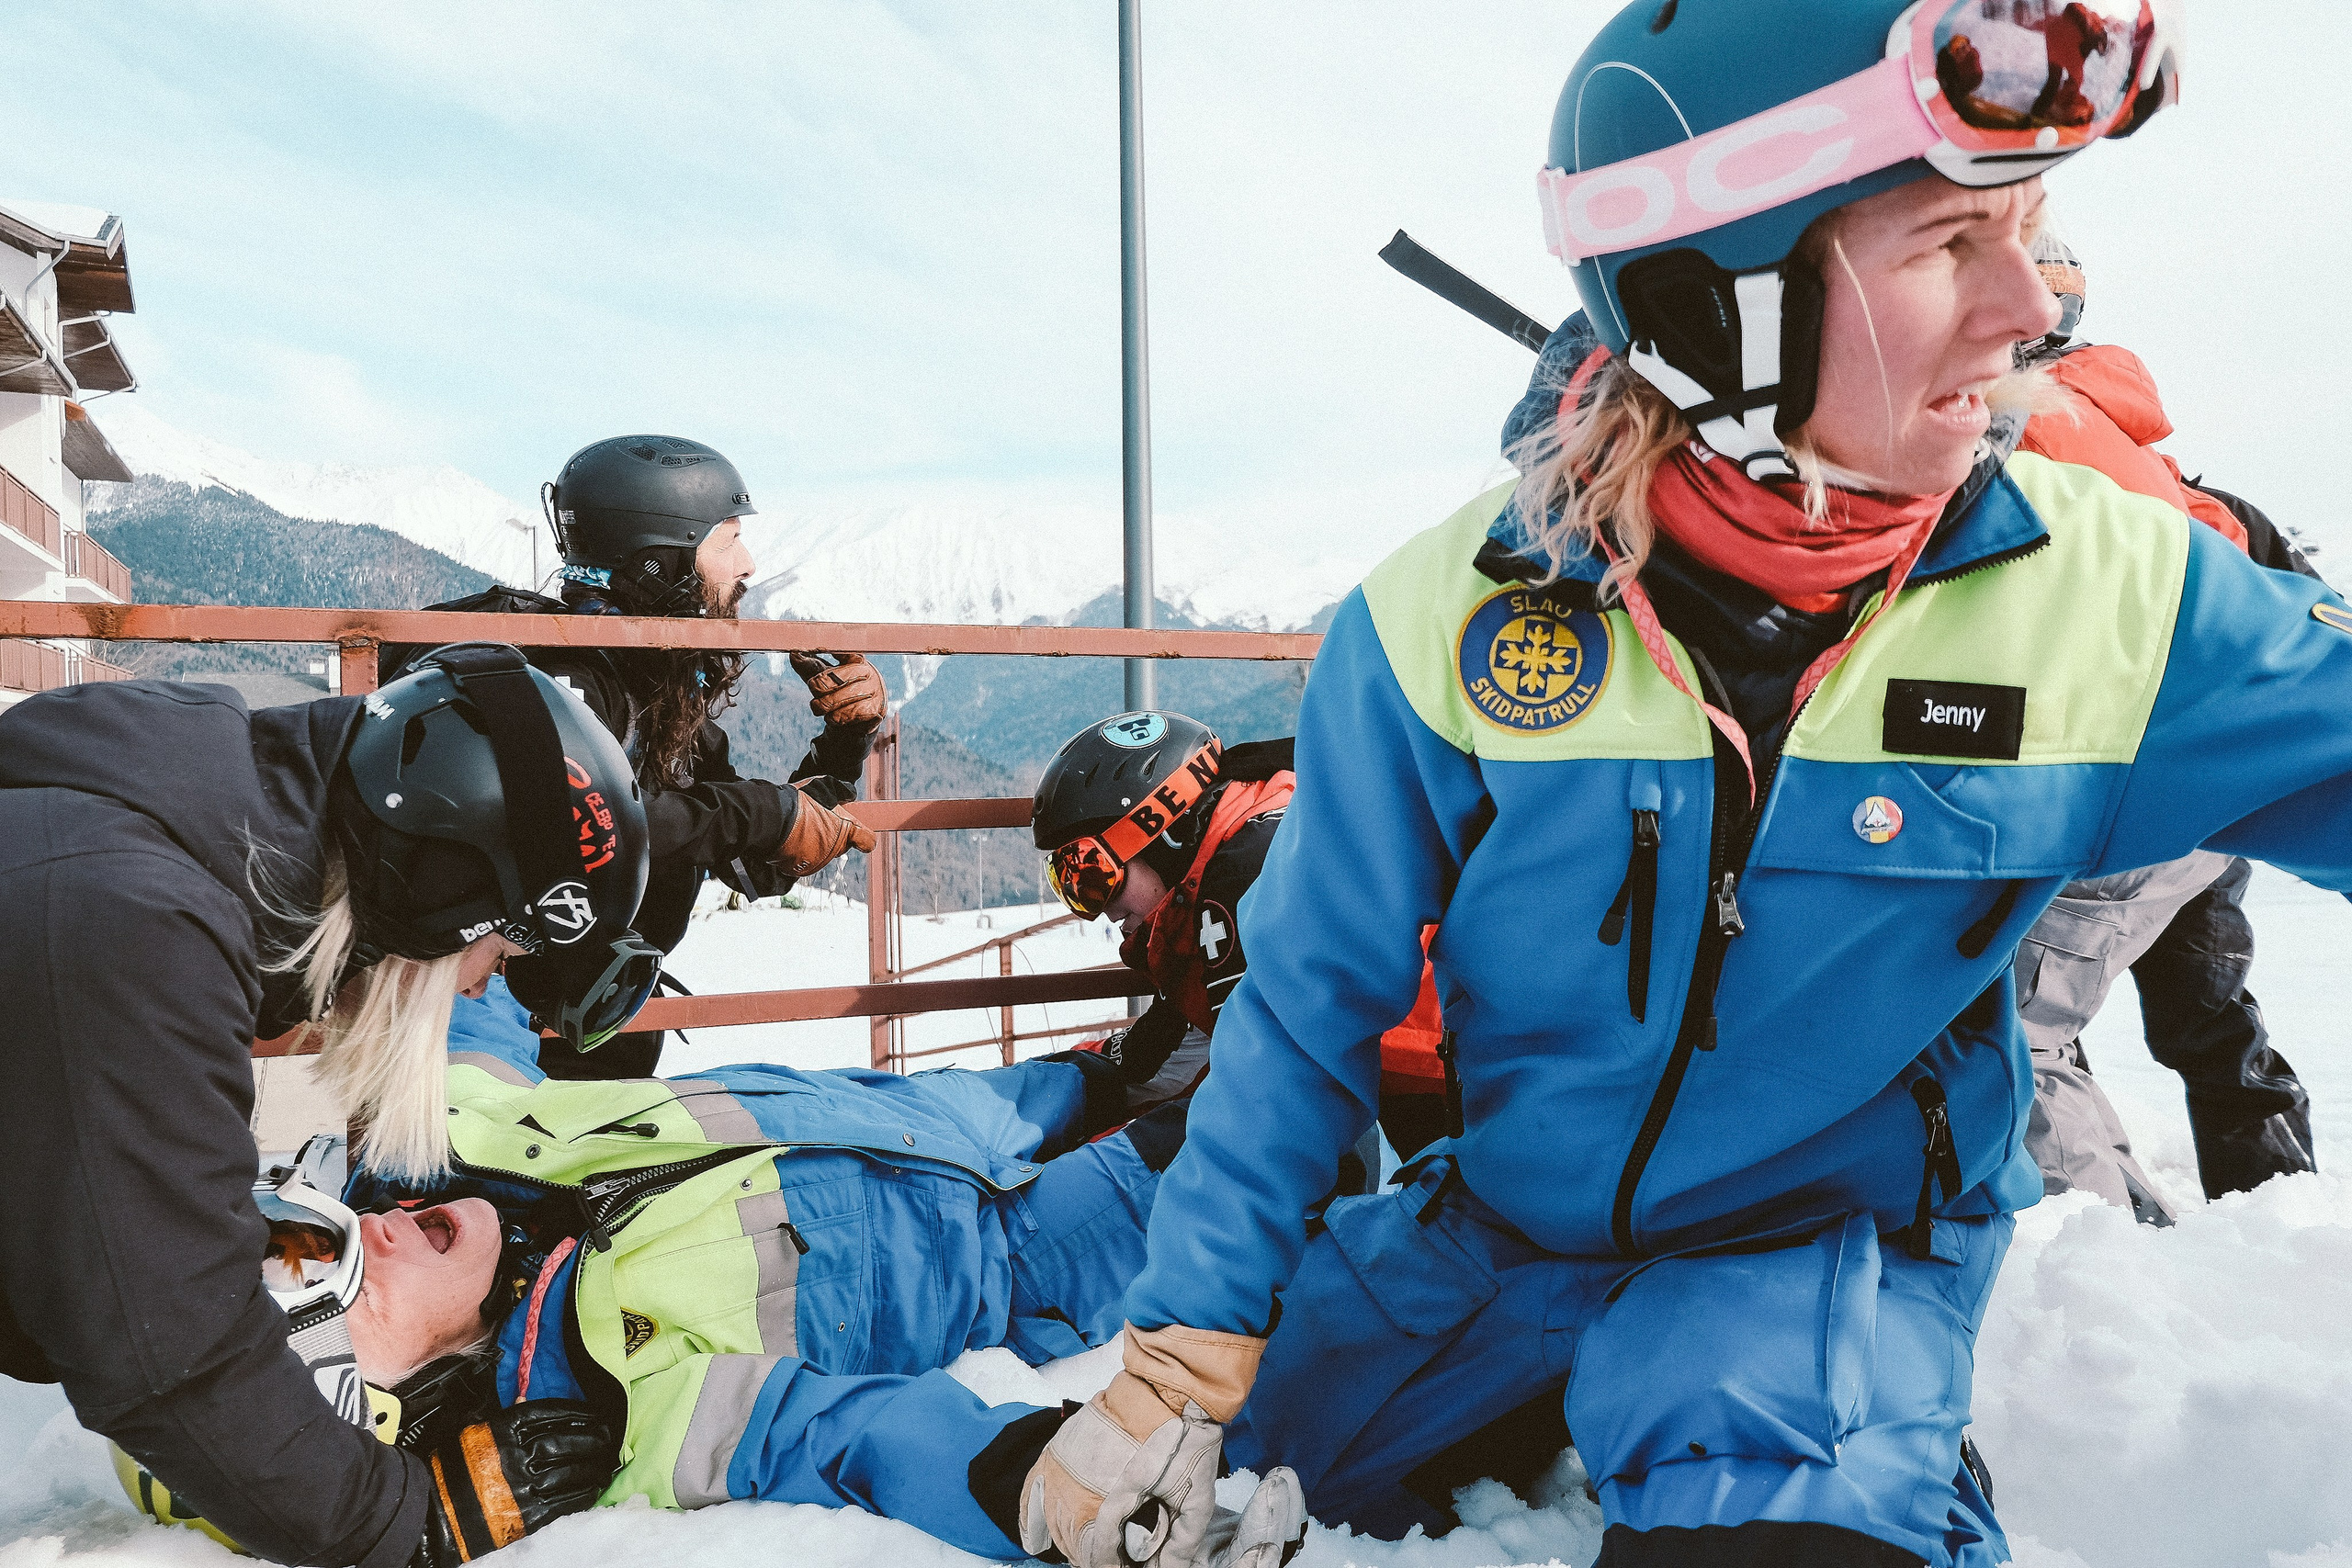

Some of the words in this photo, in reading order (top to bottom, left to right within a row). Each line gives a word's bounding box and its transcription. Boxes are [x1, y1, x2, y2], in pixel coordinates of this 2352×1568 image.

[1470, 676, 1597, 726] SKIDPATRULL
[1920, 698, 1986, 732] Jenny
[1130, 784, 1187, 838] BE
